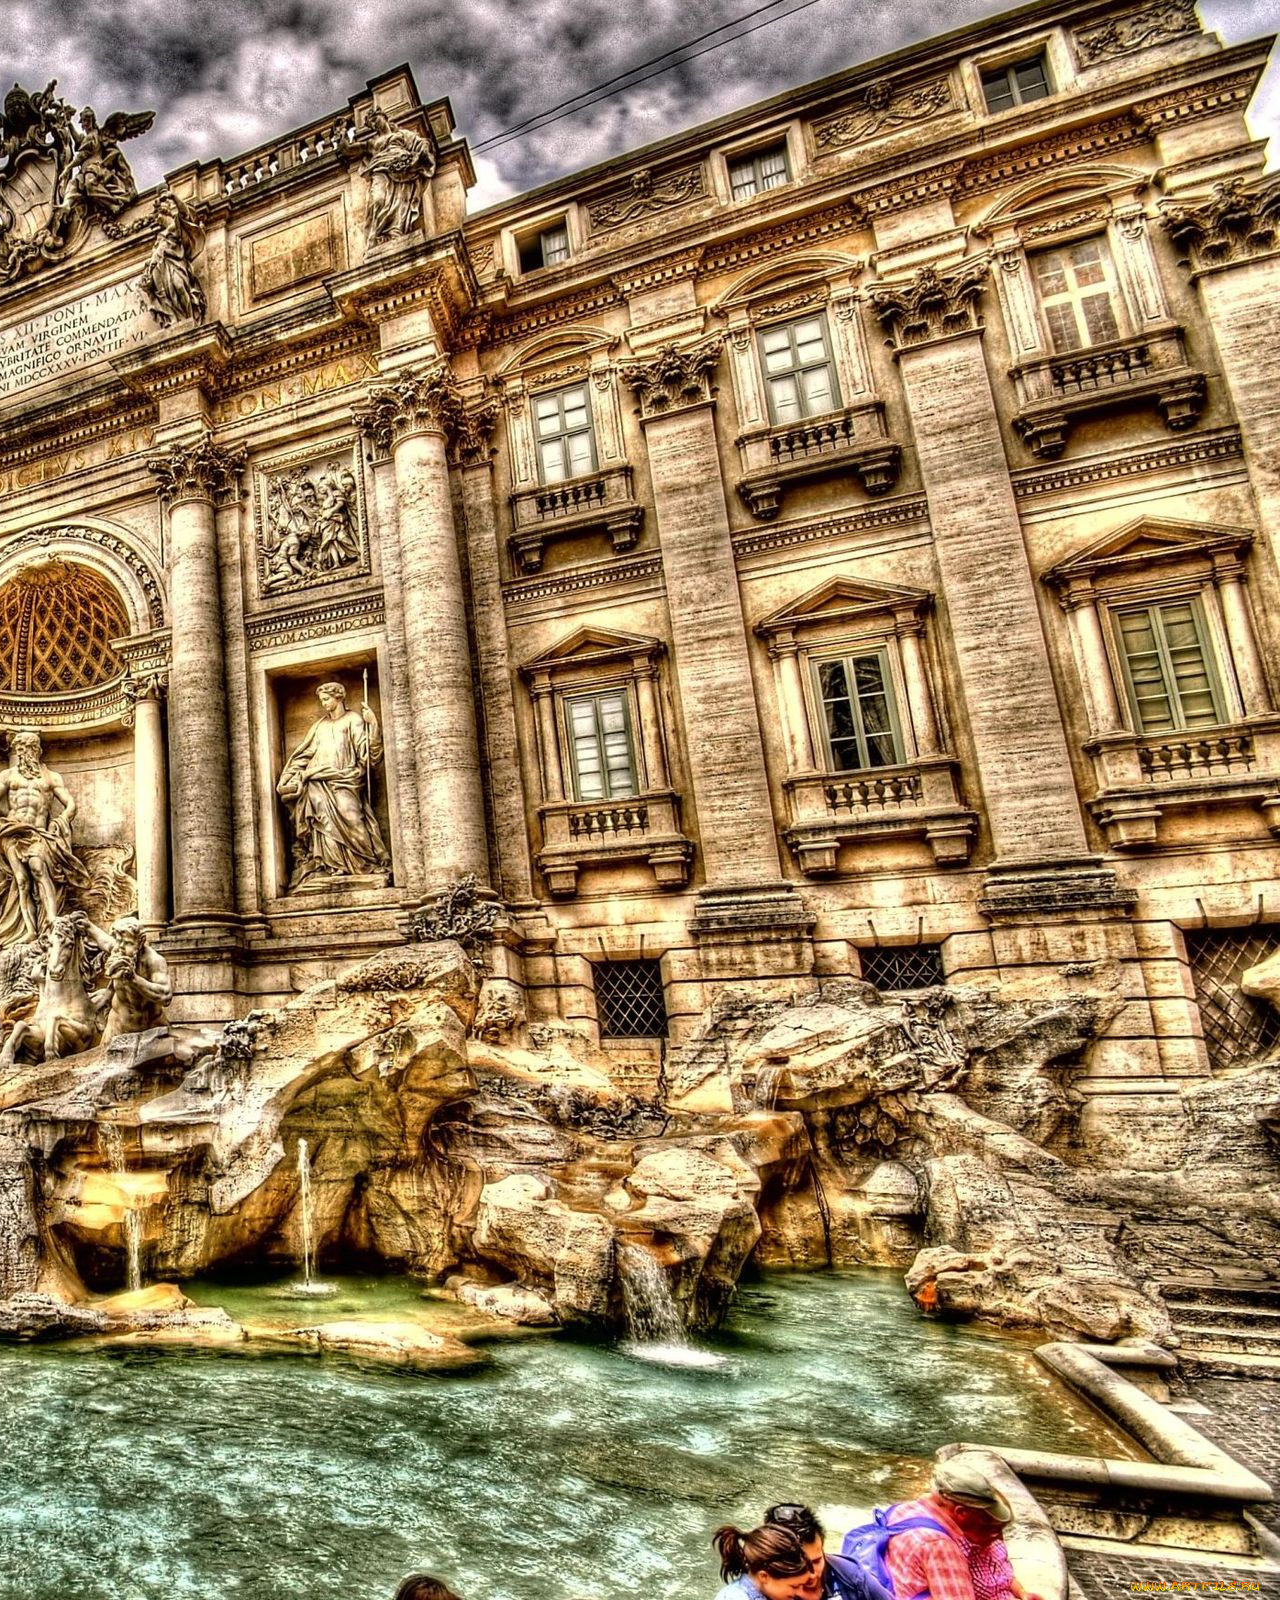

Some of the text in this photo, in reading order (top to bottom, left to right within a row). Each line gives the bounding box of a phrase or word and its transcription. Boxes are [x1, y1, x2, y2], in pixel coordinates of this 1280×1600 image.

[31, 314, 88, 343] VIRGINEM
[56, 300, 149, 347] COMMENDATAM
[66, 327, 120, 355] ORNAVIT
[301, 354, 379, 397] MAX
[250, 633, 295, 650] SOLVTVM
